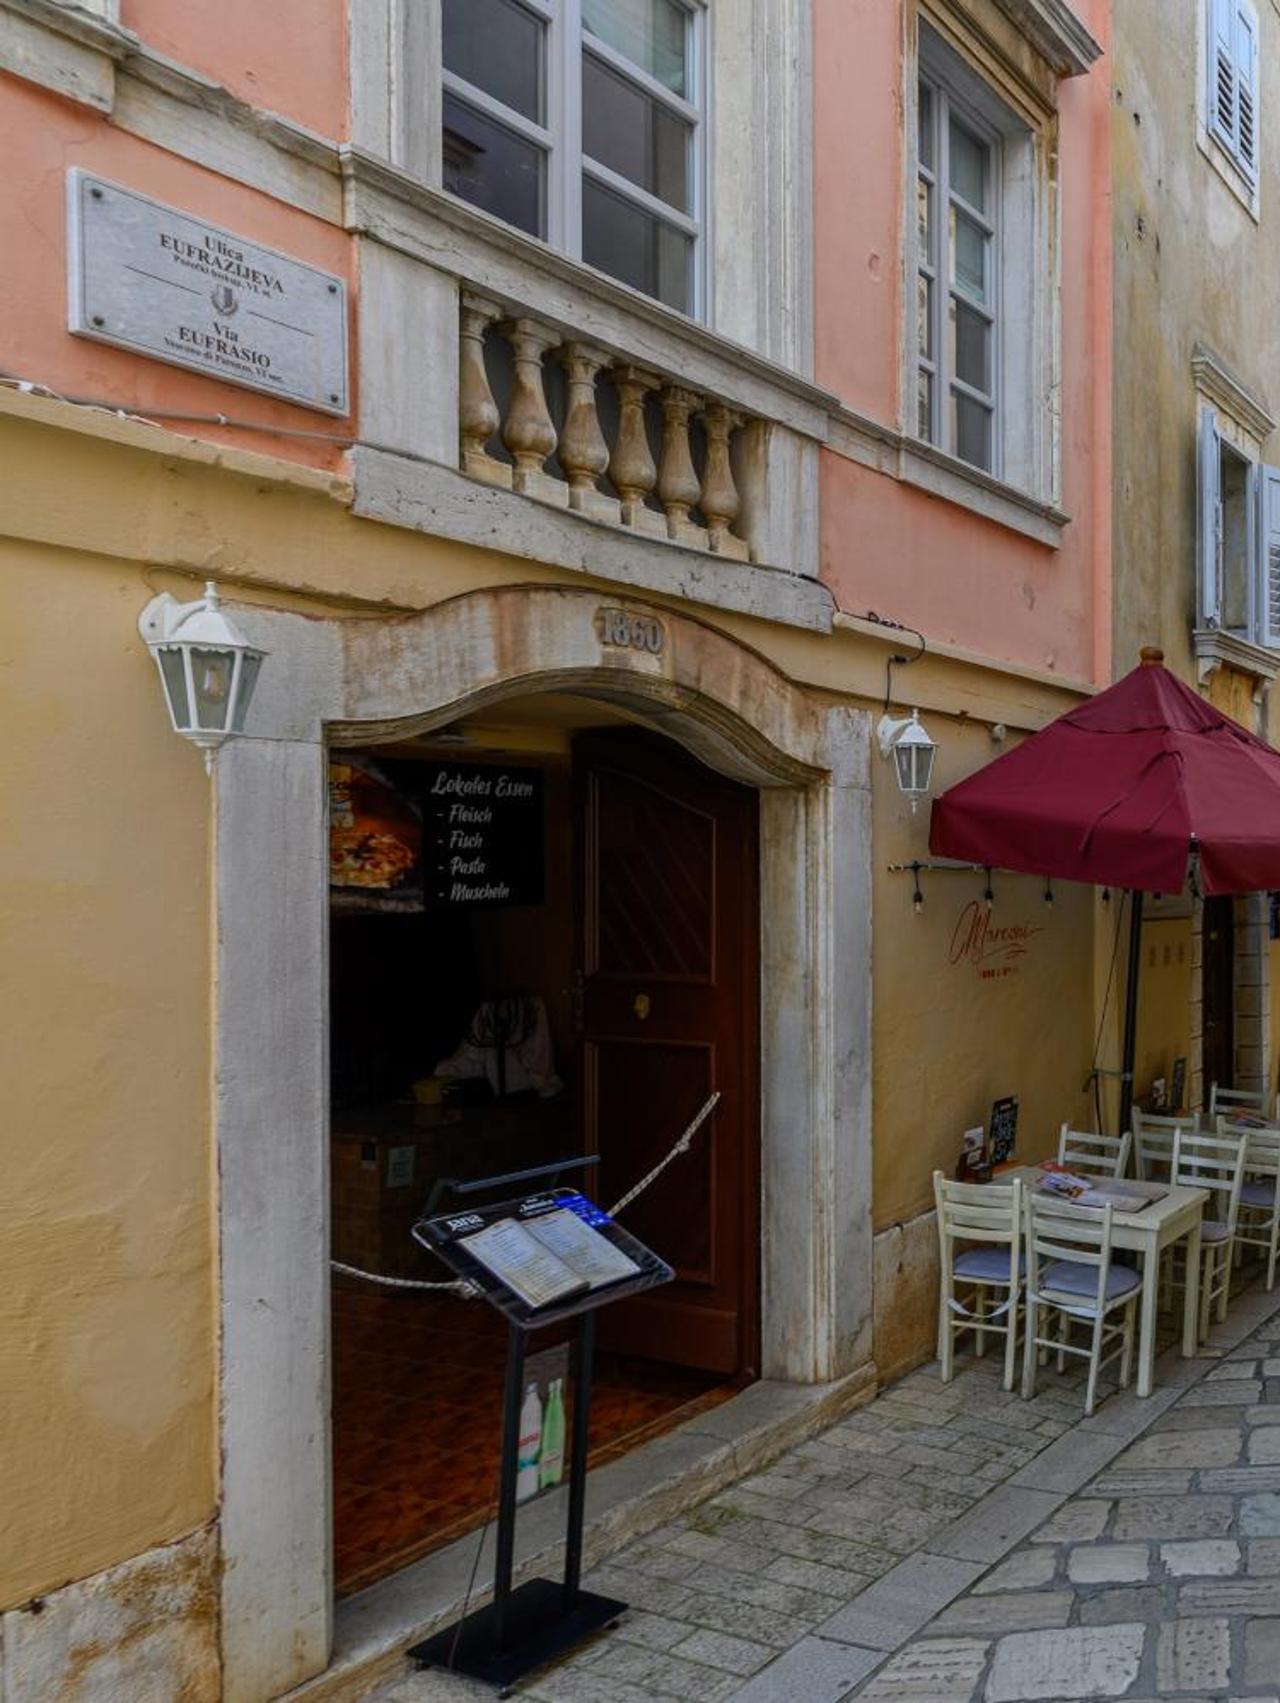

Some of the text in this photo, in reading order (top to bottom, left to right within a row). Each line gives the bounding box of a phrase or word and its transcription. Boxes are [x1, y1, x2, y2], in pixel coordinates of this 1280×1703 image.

[204, 236, 244, 262] Ulica
[160, 234, 284, 294] EUFRAZIJEVA
[213, 321, 239, 342] Via
[179, 326, 271, 368] EUFRASIO
[430, 770, 534, 799] Lokales Essen
[449, 803, 493, 824] Fleisch
[449, 829, 484, 849] Fisch
[449, 855, 487, 877] Pasta
[449, 881, 511, 902] Muscheln
